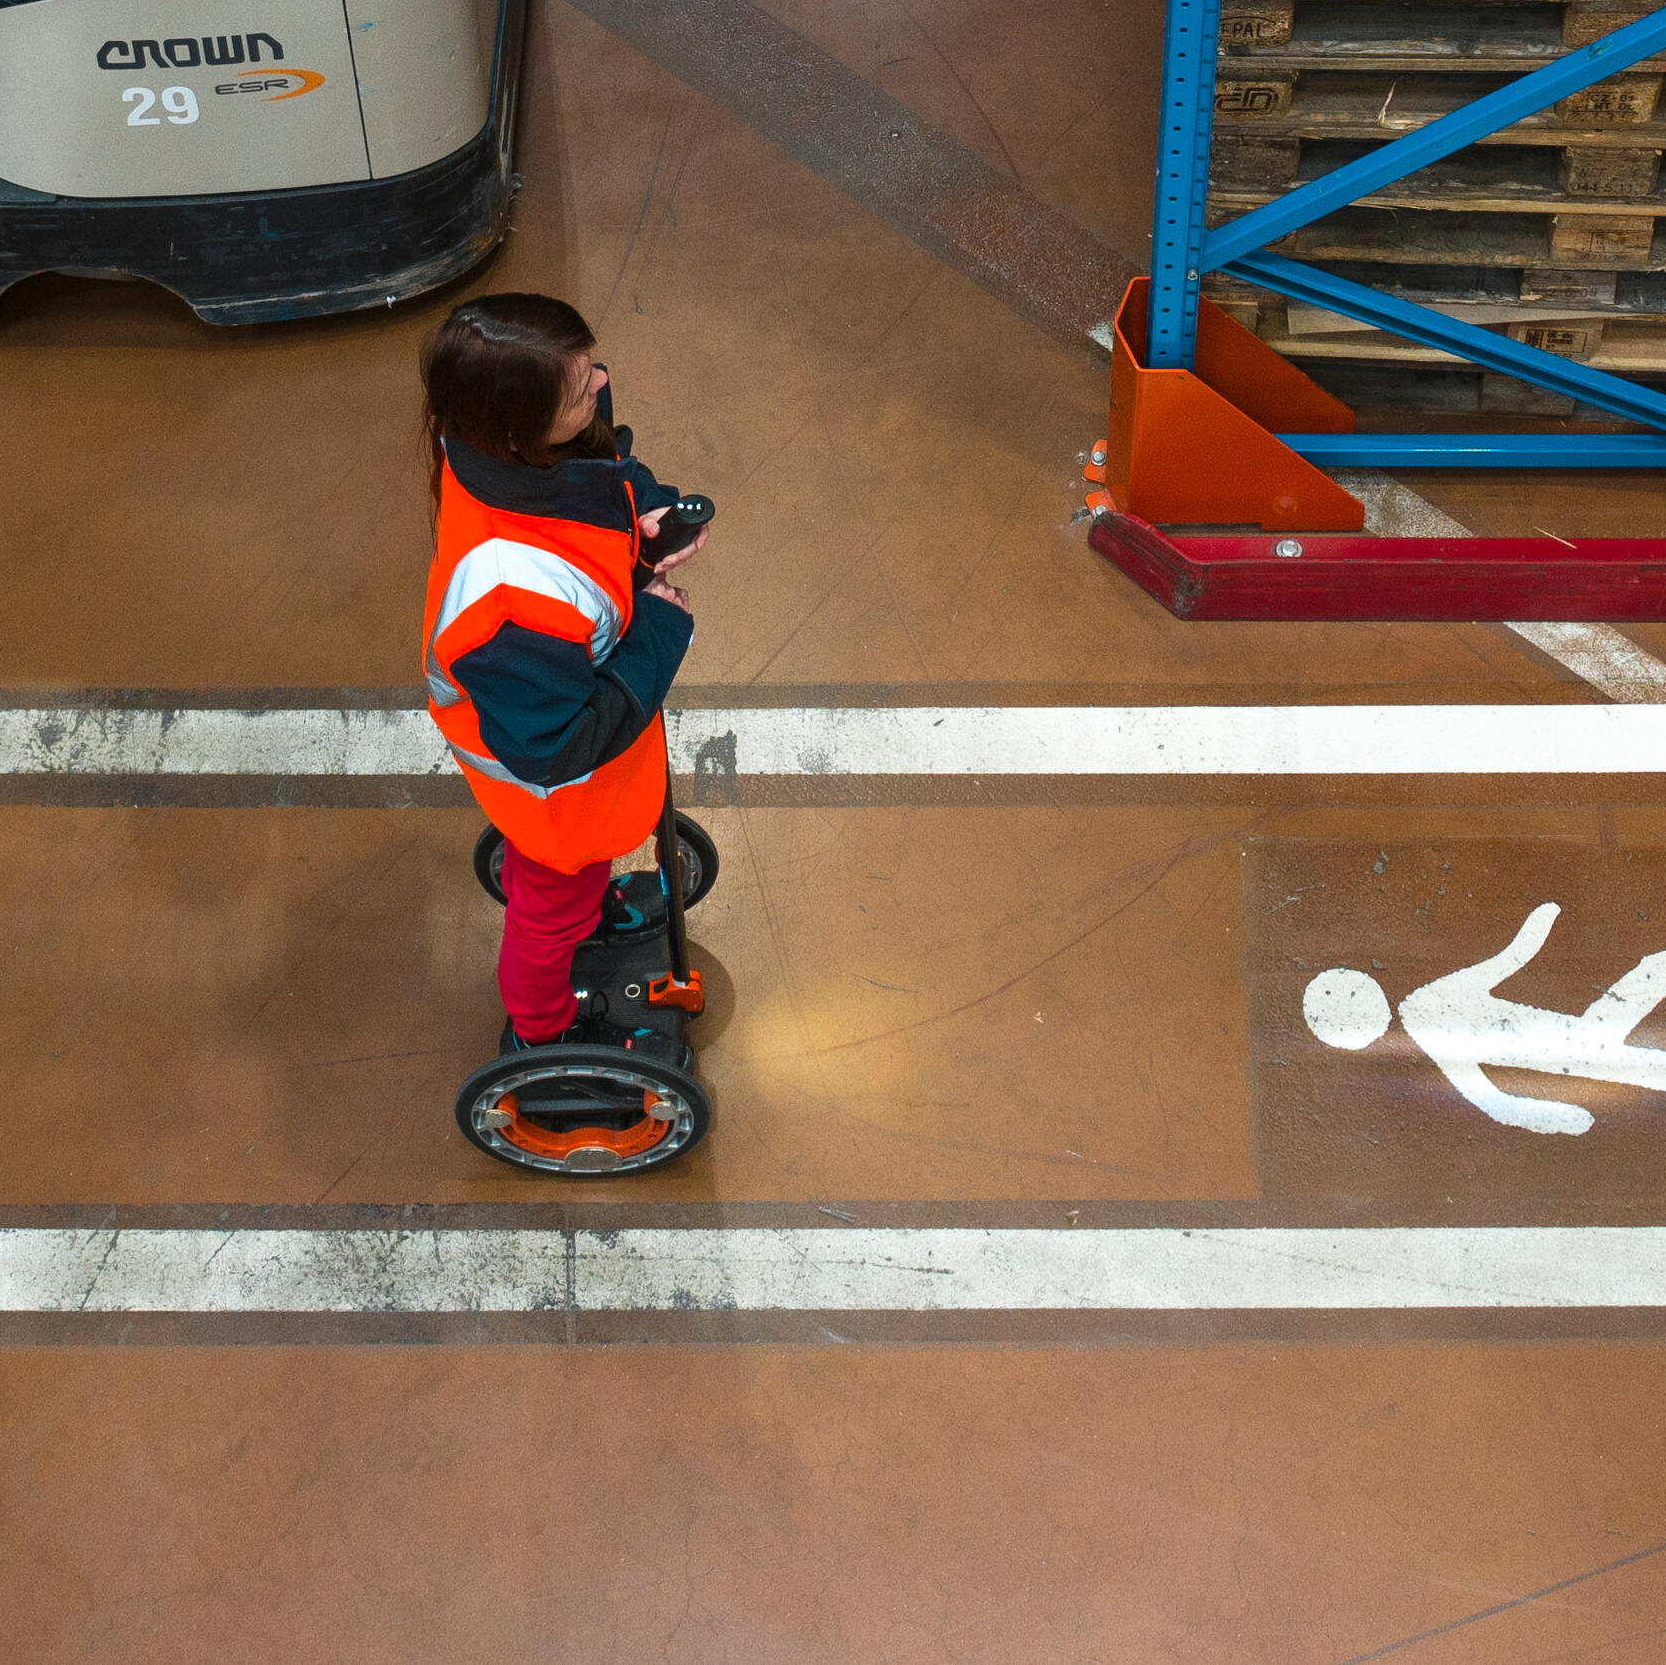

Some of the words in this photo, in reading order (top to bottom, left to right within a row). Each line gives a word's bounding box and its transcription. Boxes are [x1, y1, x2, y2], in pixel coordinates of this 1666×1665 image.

[96, 32, 284, 70] CROWN
[121, 86, 200, 127] 29
[214, 78, 290, 95] ESR
